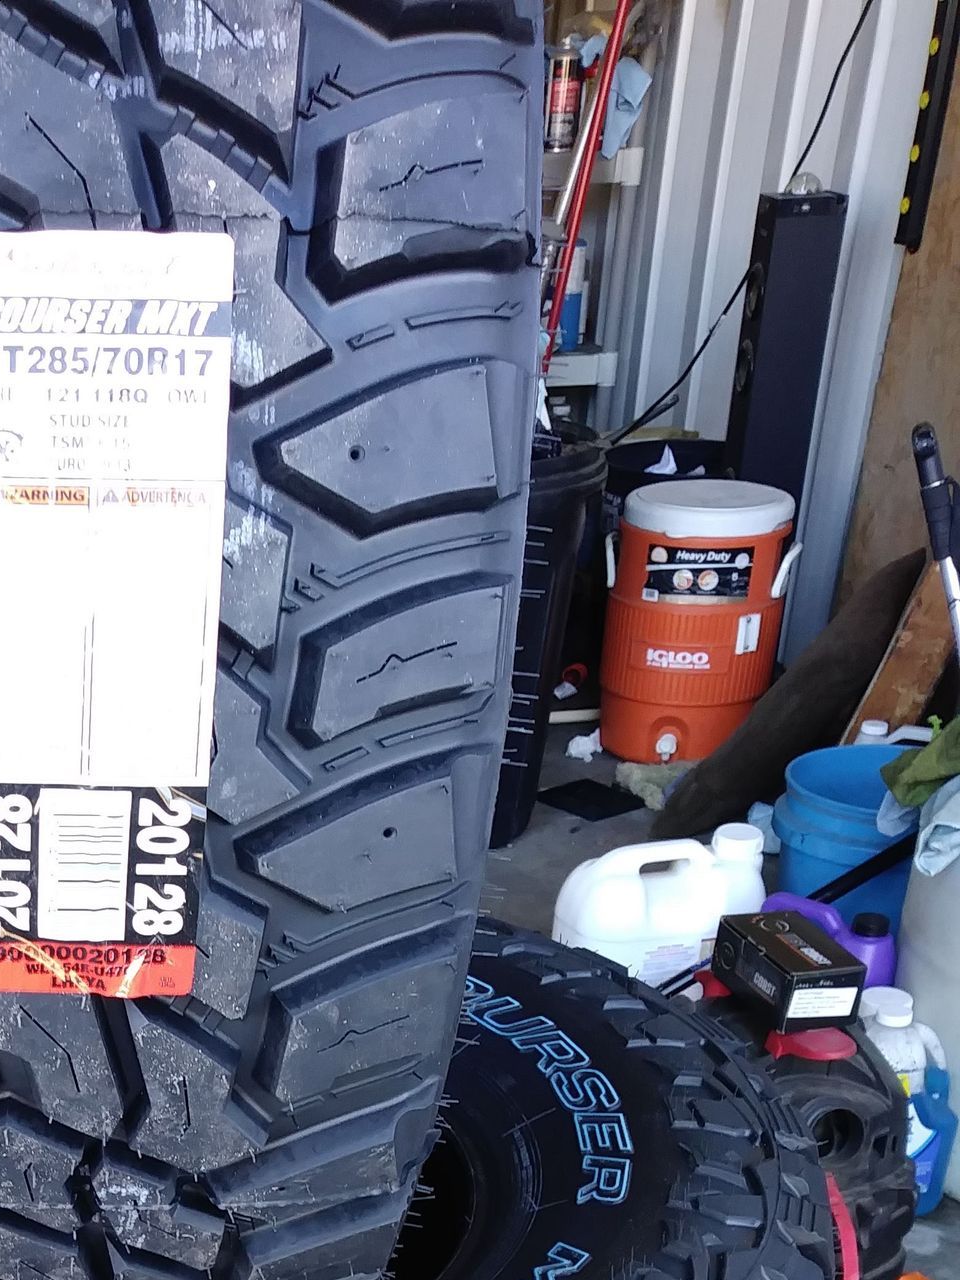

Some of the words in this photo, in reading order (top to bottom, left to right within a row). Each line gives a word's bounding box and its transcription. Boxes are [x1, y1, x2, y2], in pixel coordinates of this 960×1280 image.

[136, 299, 218, 336] MXT
[50, 415, 90, 427] STUD
[1, 487, 85, 503] WARNING
[676, 550, 707, 563] Heavy
[707, 551, 731, 563] Duty
[646, 648, 709, 668] IGLOO
[132, 797, 192, 936] 20128
[463, 974, 636, 1206] OURSER
